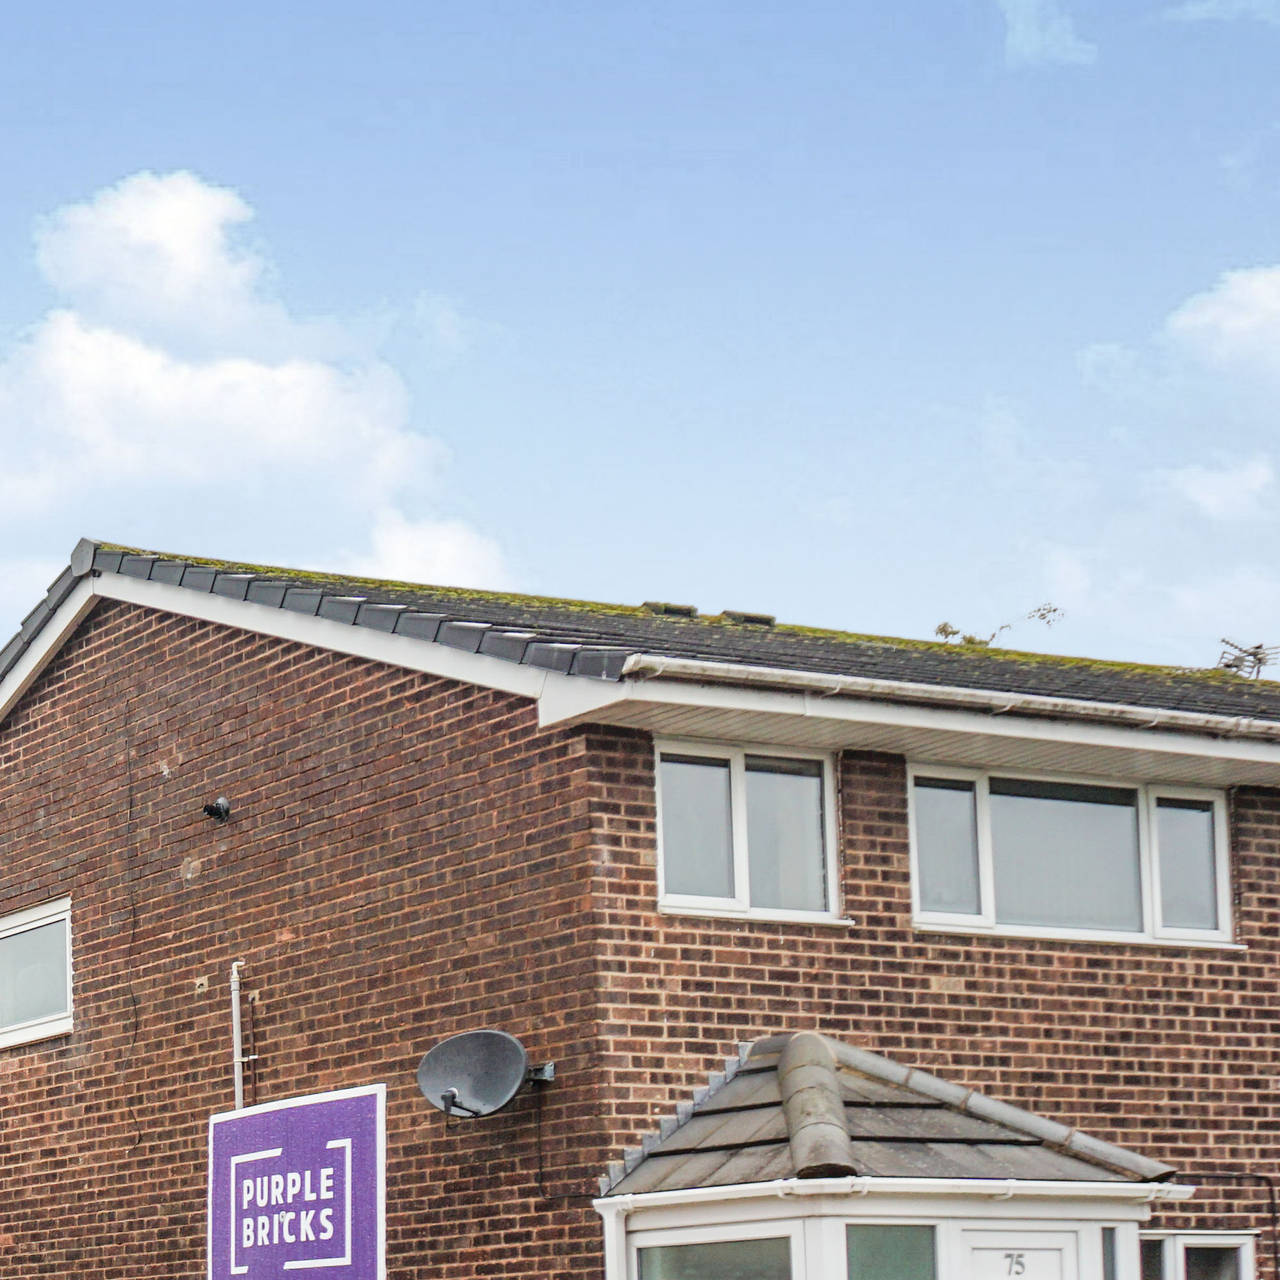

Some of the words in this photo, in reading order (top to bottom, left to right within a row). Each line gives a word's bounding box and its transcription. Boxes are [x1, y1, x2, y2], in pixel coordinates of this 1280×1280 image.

[243, 1167, 334, 1209] PURPLE
[243, 1208, 334, 1248] BRICKS
[1004, 1253, 1025, 1276] 75
